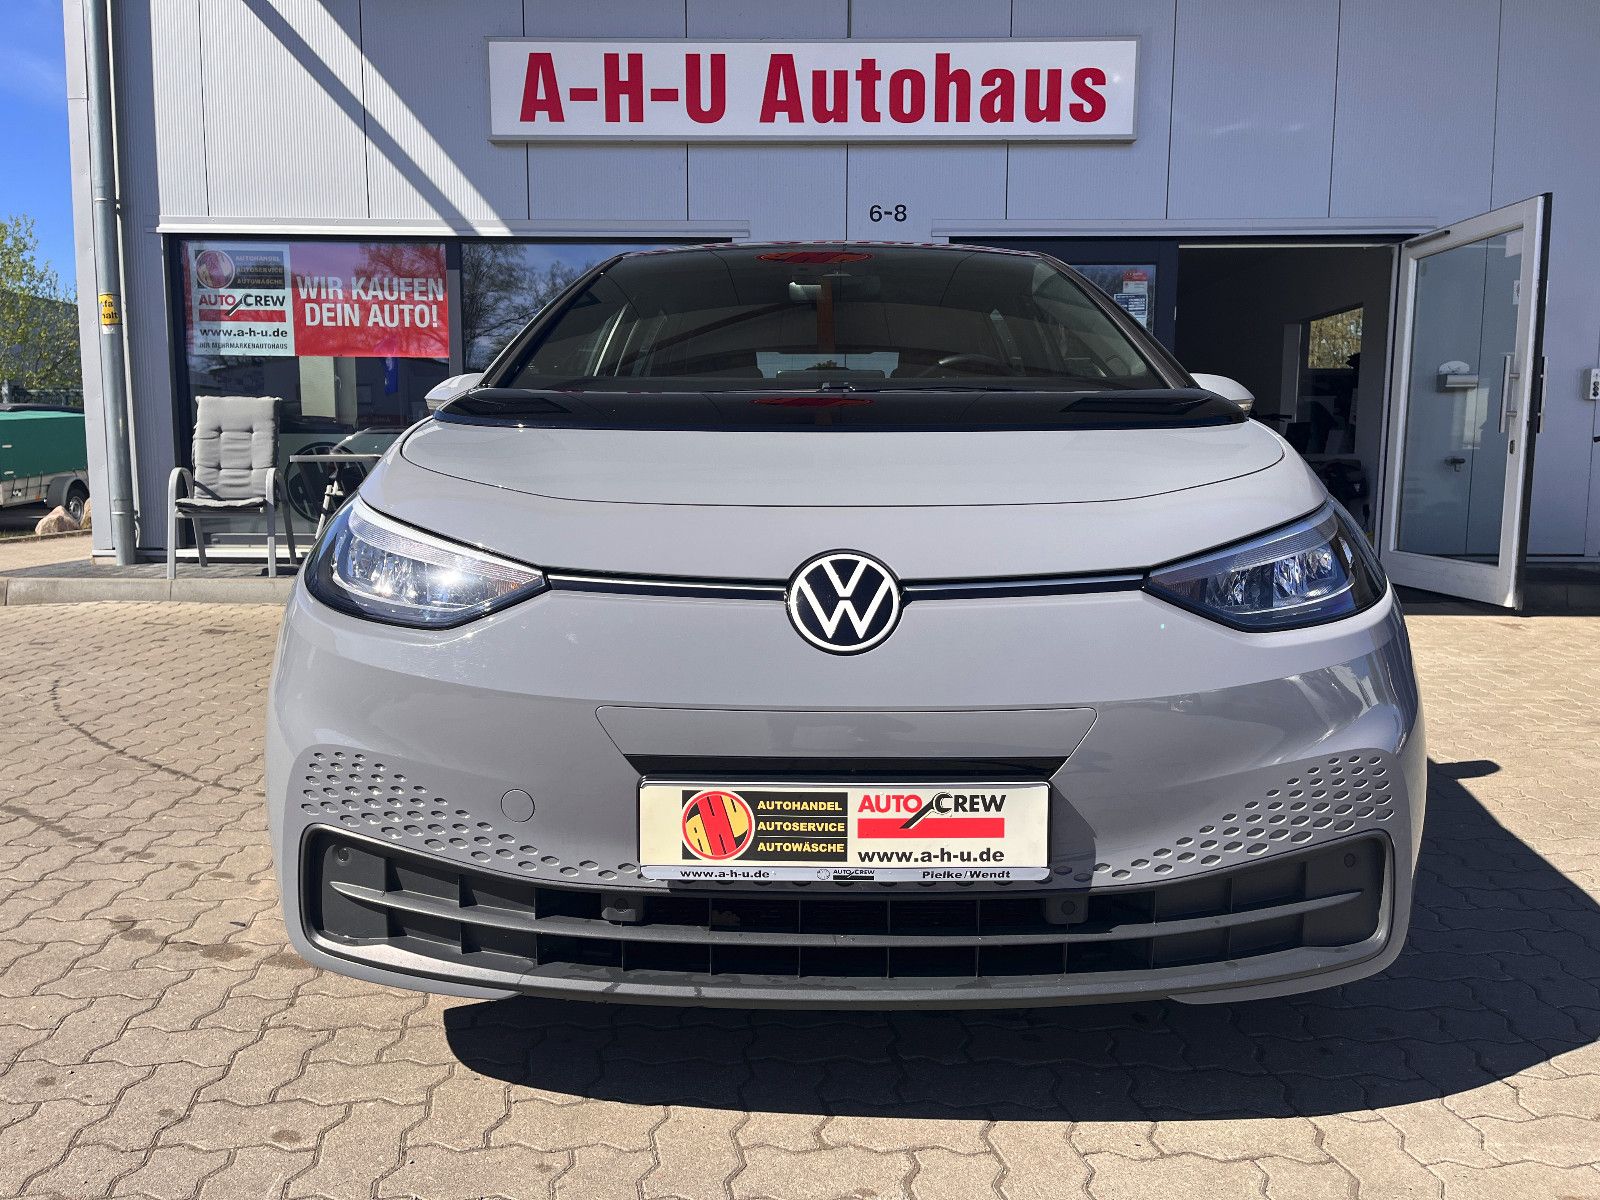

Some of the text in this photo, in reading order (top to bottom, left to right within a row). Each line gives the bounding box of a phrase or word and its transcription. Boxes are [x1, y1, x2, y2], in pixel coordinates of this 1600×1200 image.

[519, 52, 1107, 124] A-H-U Autohaus
[869, 204, 907, 222] 6-8
[296, 276, 444, 301] WIR KAUFEN
[199, 293, 286, 306] AUTO CREW
[304, 303, 438, 328] DEIN AUTO!
[199, 328, 288, 338] www.a-h-u.de
[757, 800, 842, 811] AUTOHANDEL
[857, 792, 1007, 814] AUTO CREW
[757, 821, 845, 832] AUTOSERVICE
[757, 842, 845, 853] AUTOWÄSCHE
[857, 848, 1005, 863] www.a-h-u.de
[680, 869, 770, 878] www.a-h-u.de
